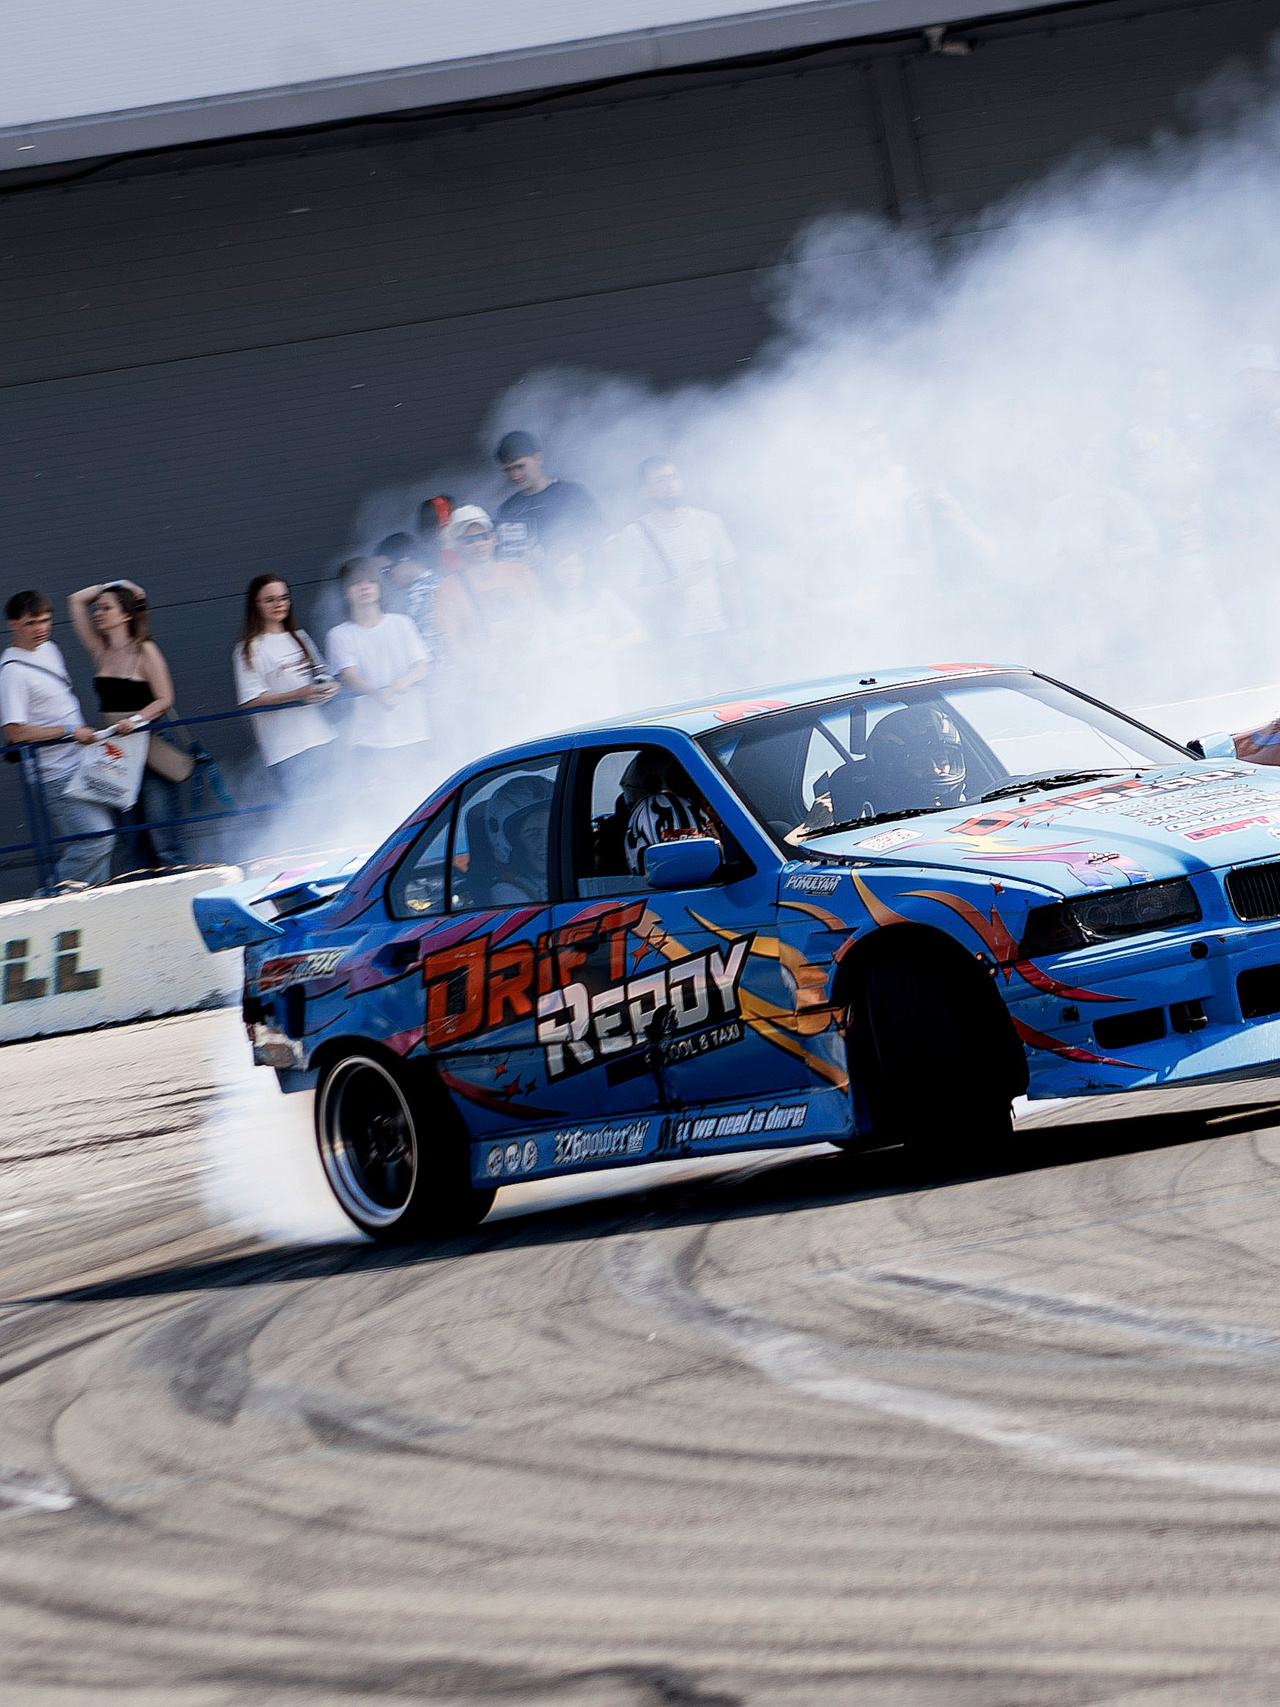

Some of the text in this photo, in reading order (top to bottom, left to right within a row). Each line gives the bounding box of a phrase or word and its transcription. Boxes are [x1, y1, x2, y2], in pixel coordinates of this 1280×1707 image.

[537, 938, 752, 1077] READY
[699, 1033, 709, 1050] &
[710, 1022, 740, 1045] TAXI
[691, 1116, 716, 1140] we
[715, 1109, 751, 1135] need
[750, 1111, 765, 1132] is
